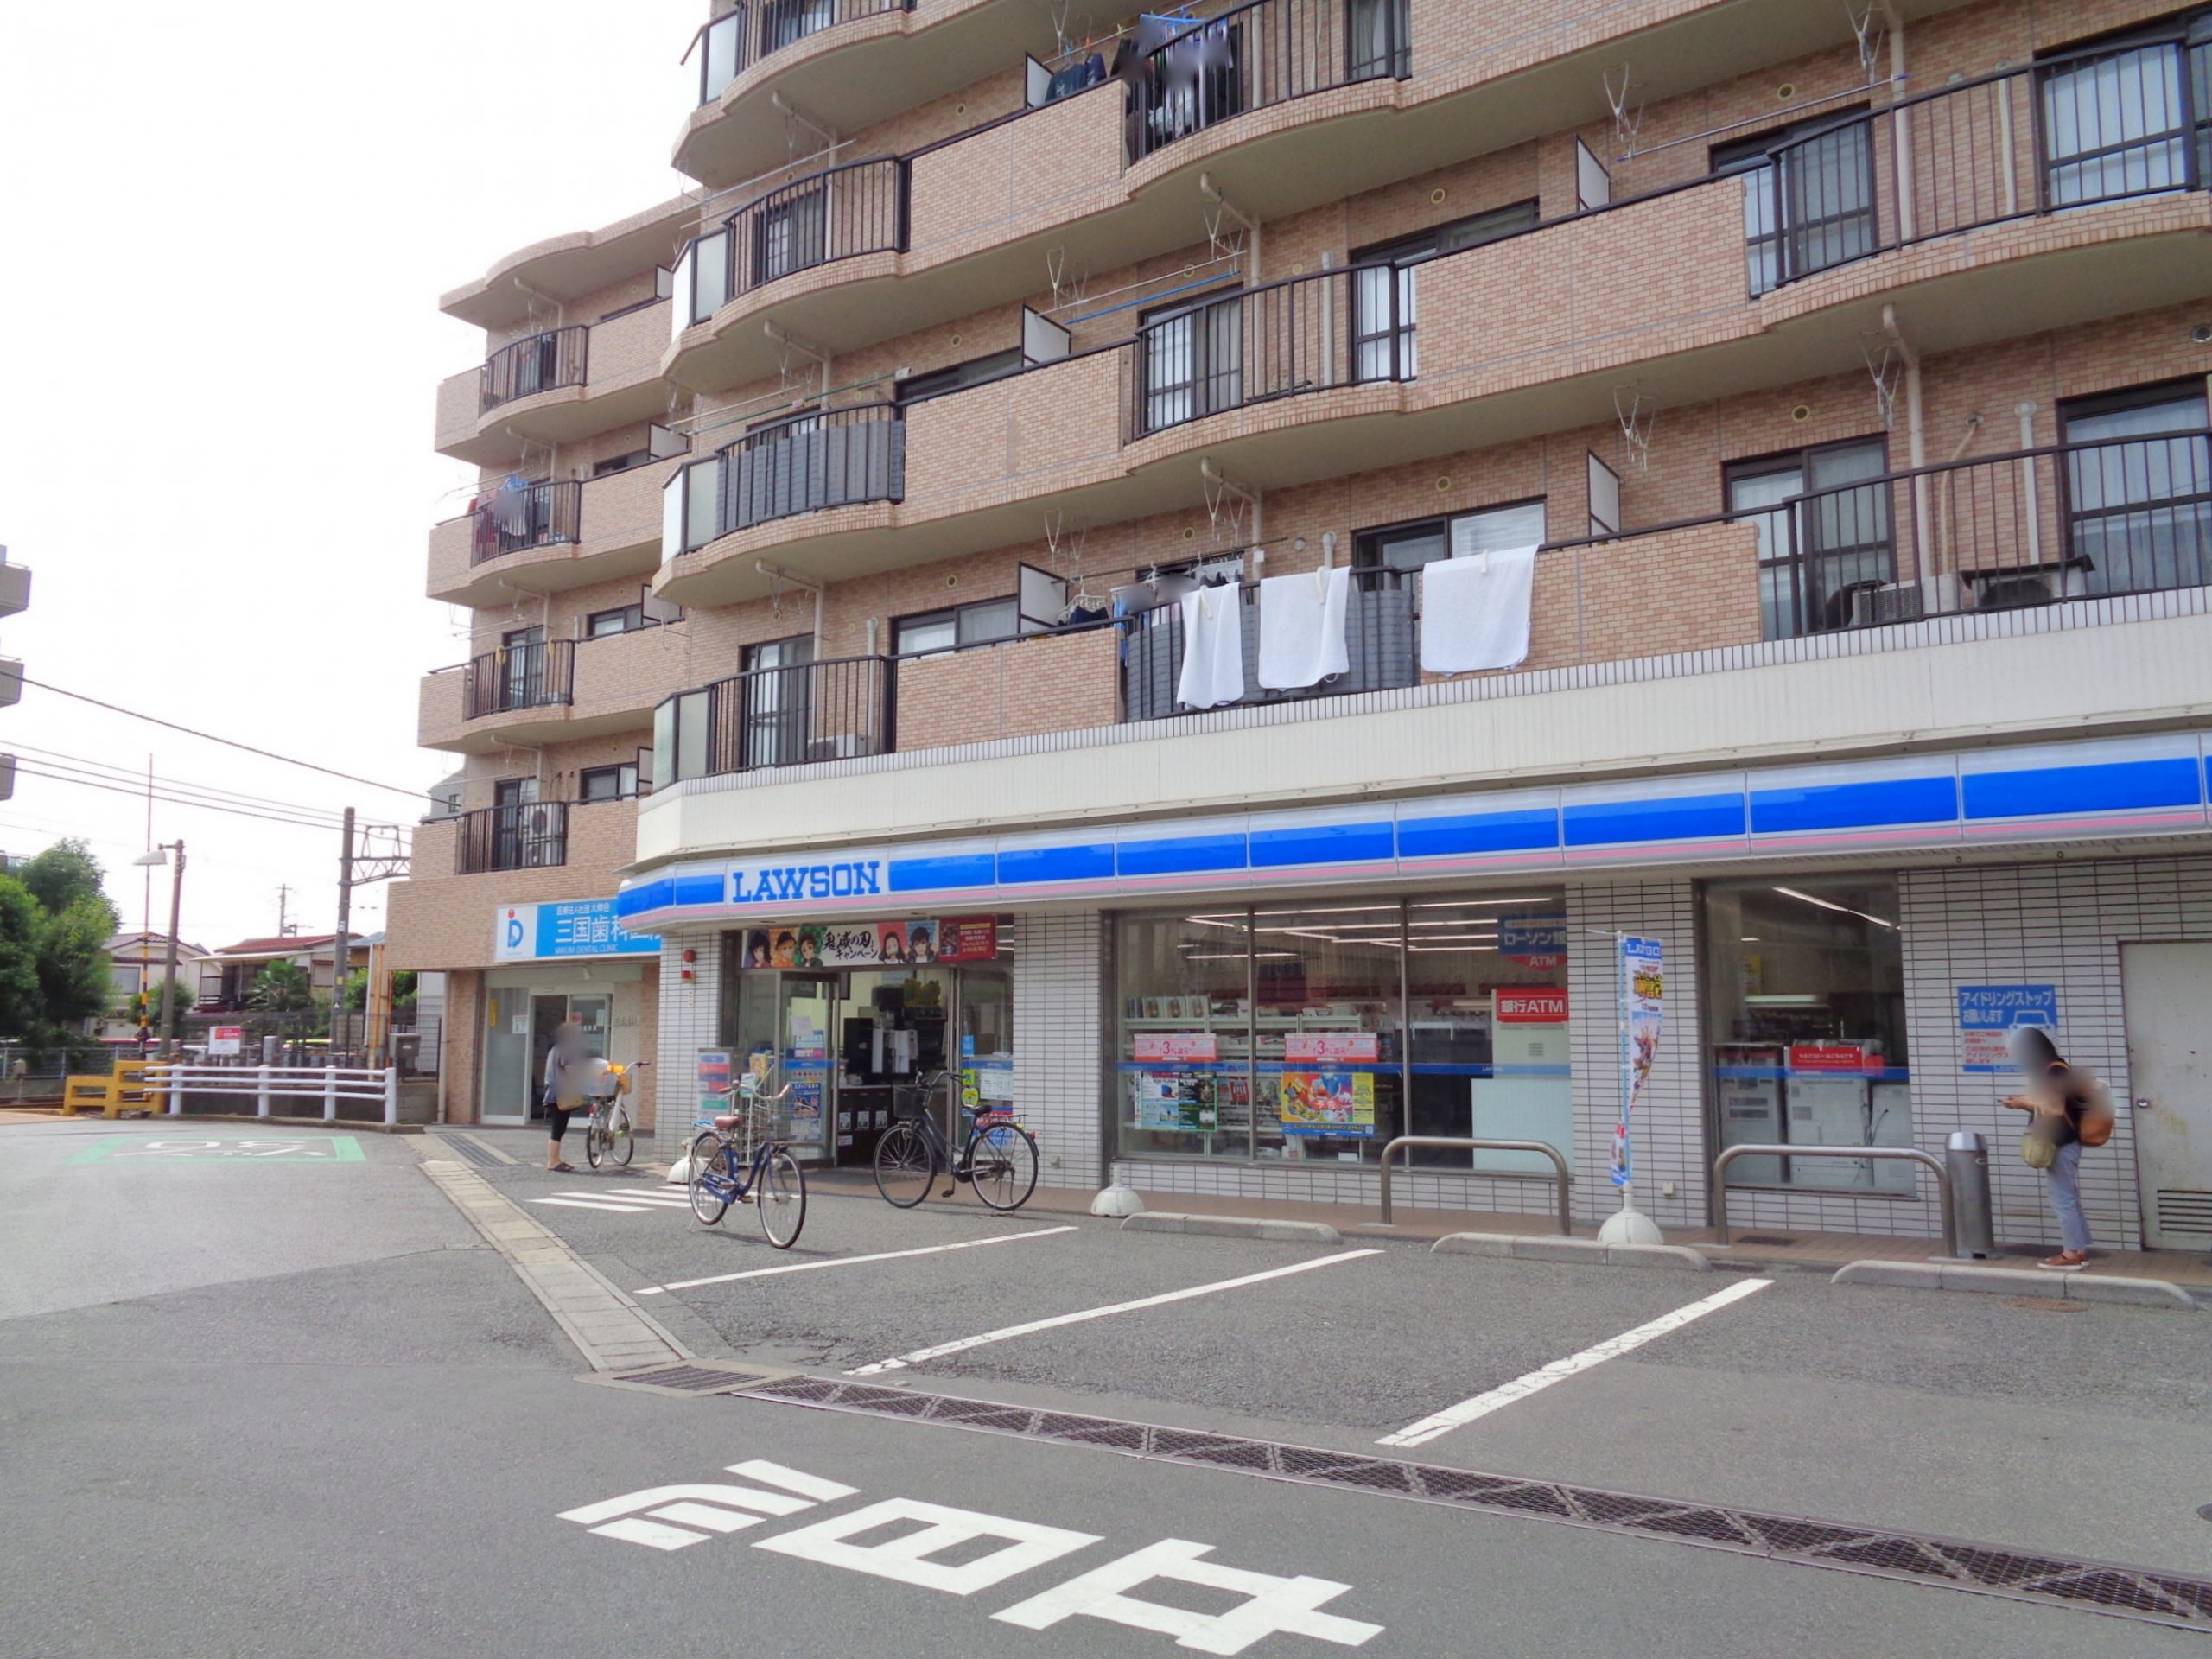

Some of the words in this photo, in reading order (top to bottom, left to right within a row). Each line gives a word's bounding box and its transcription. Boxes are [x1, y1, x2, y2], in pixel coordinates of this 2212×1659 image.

[733, 861, 880, 903] LAWSON
[555, 915, 662, 944] 三国歯科
[1529, 955, 1557, 967] ATM
[1501, 999, 1564, 1014] 銀行ATM
[1961, 991, 2053, 1007] アイドリングストップ
